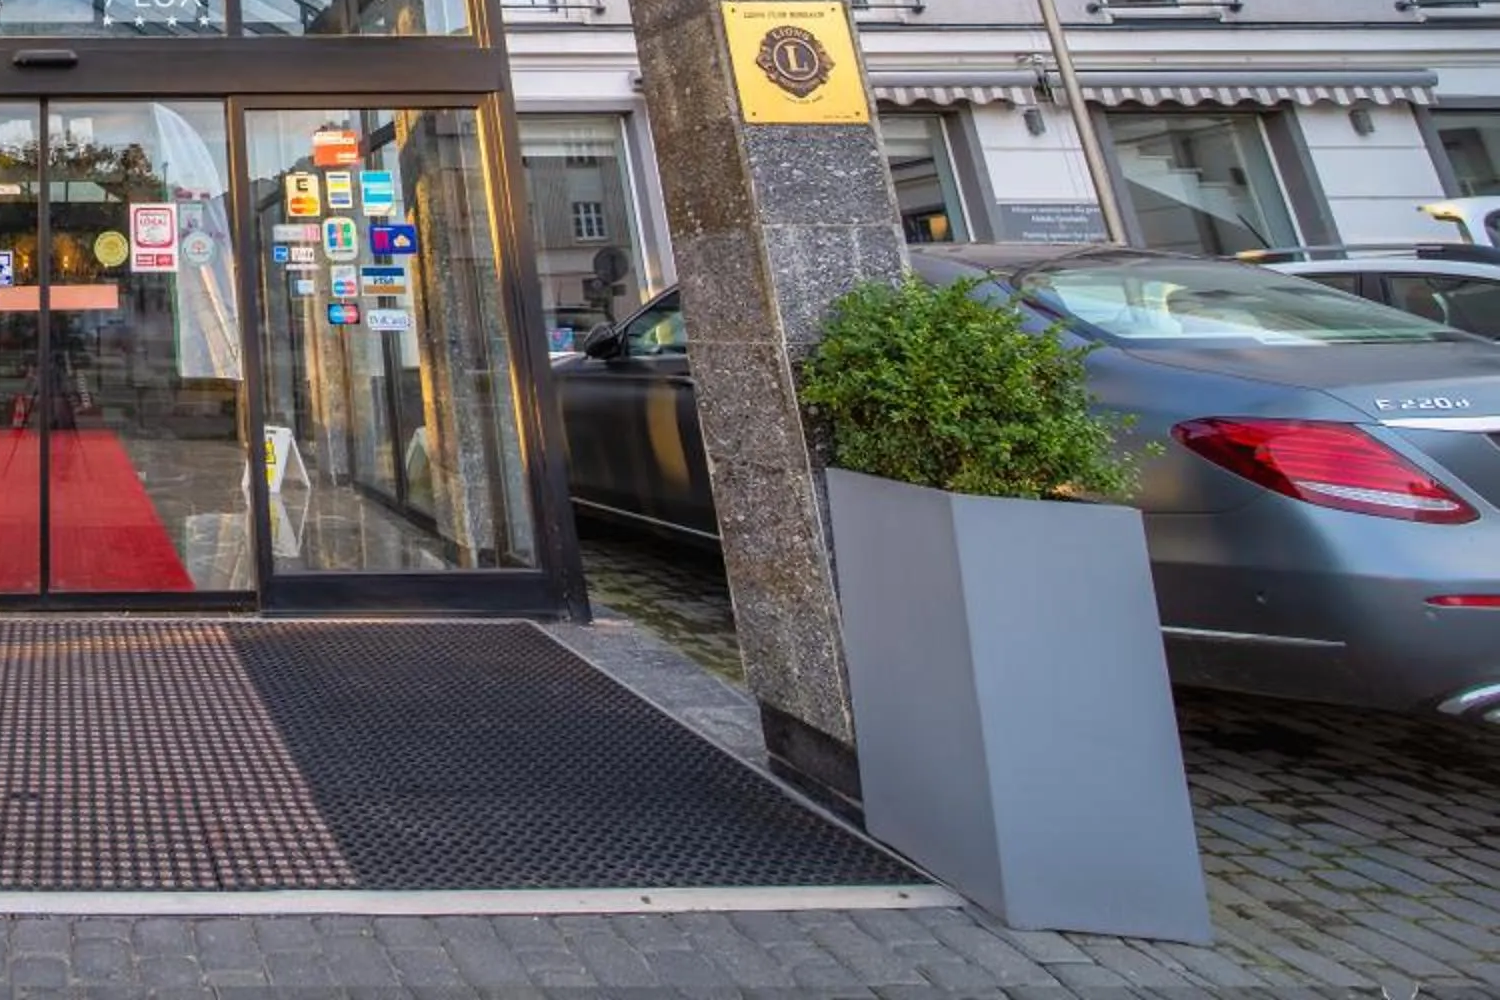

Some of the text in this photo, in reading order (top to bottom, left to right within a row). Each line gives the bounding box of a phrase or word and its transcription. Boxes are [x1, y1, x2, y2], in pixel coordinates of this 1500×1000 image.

[771, 27, 810, 41] LIONS
[784, 45, 810, 72] L
[373, 277, 394, 285] VISA
[1376, 398, 1392, 410] E
